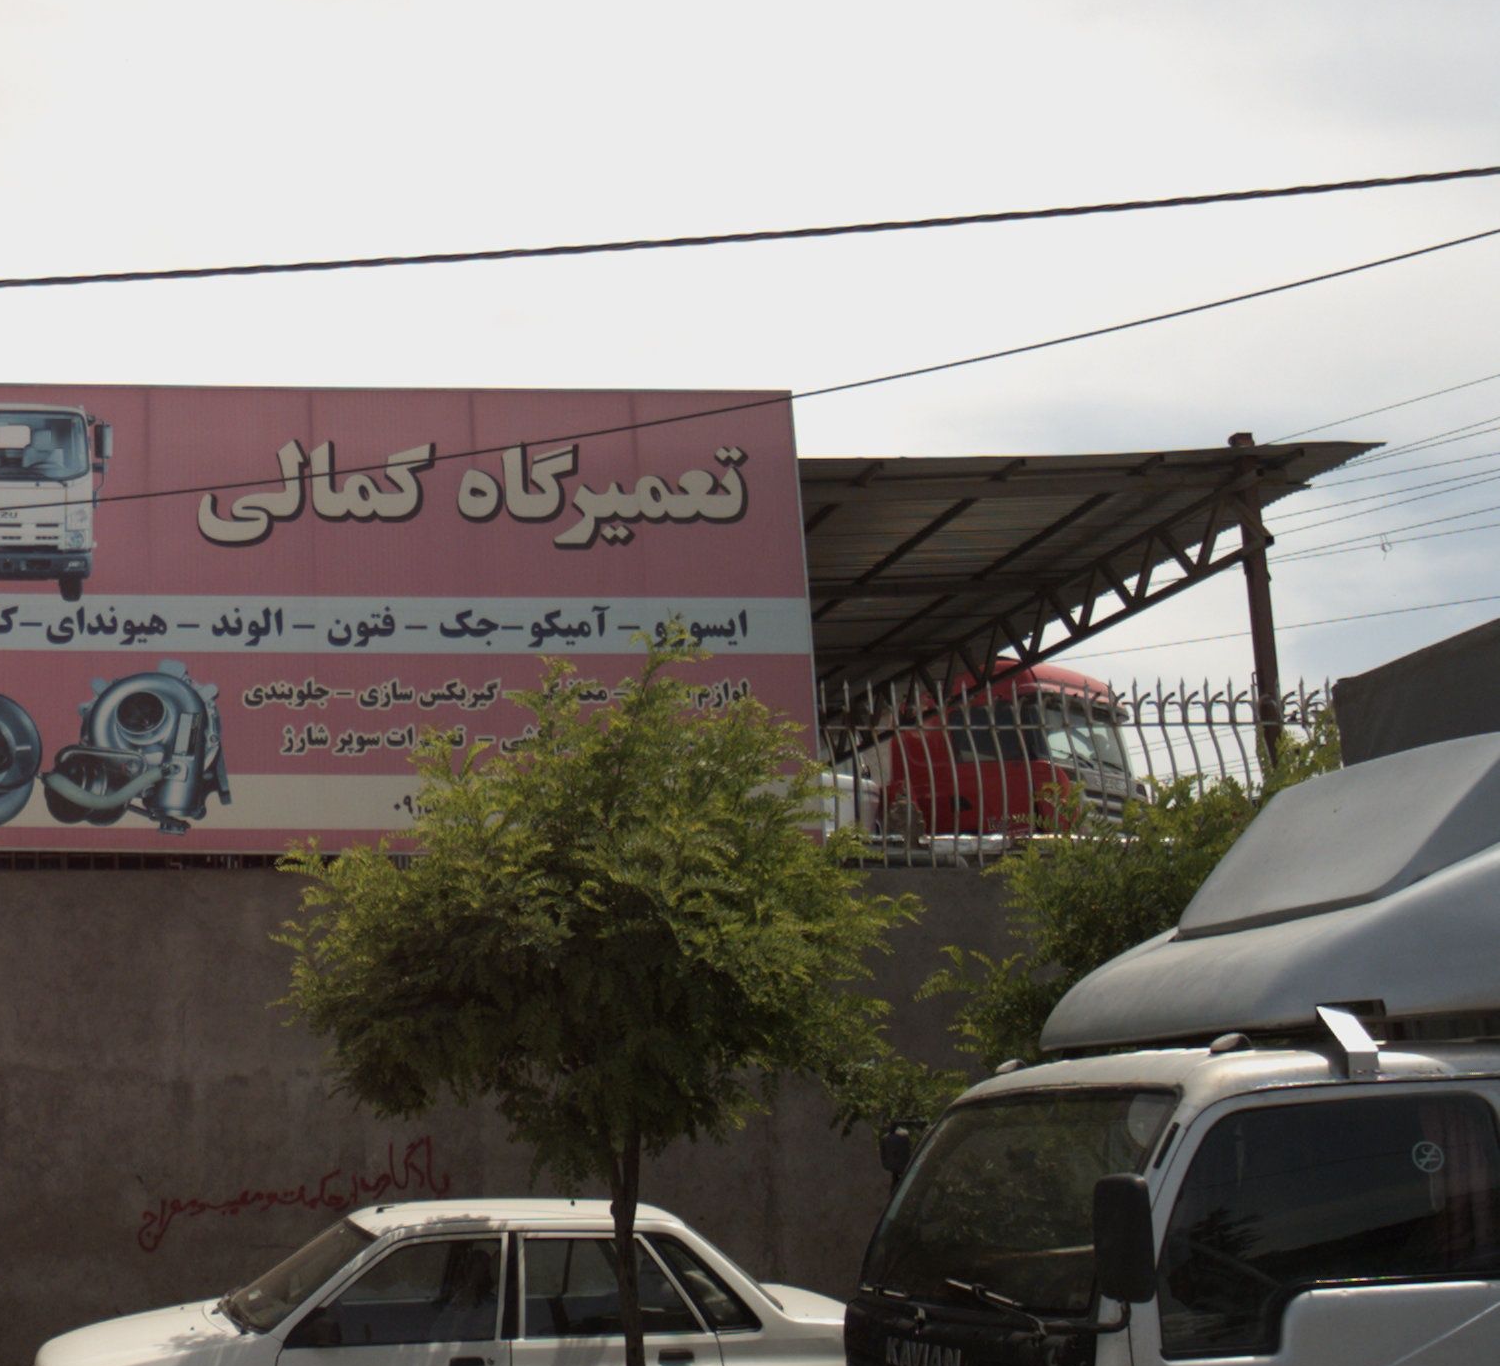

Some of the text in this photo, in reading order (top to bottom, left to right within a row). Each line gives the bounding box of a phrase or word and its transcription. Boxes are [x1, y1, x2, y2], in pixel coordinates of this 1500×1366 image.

[197, 438, 749, 550] تعمیرگاه کمالی
[211, 607, 283, 646] الوند
[327, 606, 396, 647] فتون
[244, 678, 330, 707] جلوبندی
[360, 681, 413, 708] سازی
[420, 680, 498, 707] گیربکس
[281, 725, 329, 754] شارژ
[334, 733, 380, 754] سوپر
